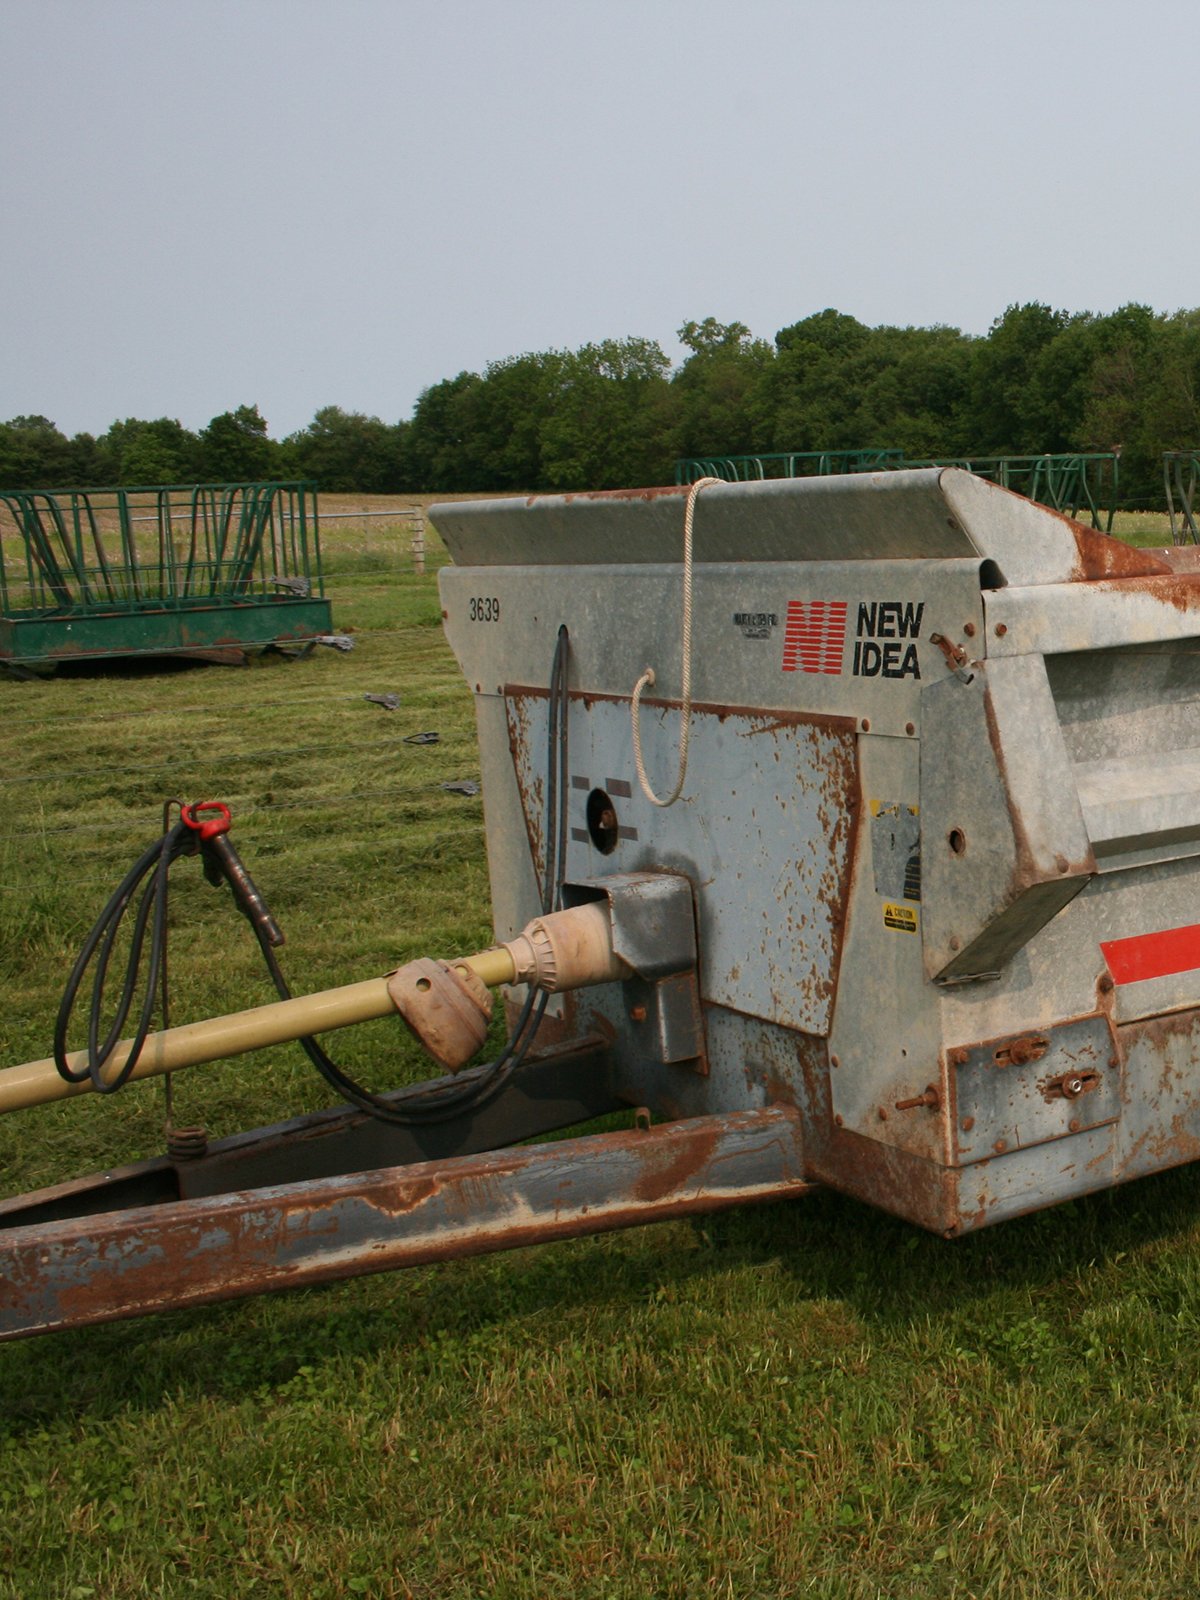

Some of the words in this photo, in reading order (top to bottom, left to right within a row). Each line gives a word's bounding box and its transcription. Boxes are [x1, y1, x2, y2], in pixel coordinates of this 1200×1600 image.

[469, 597, 500, 622] 3639
[857, 601, 925, 638] NEW
[852, 641, 922, 680] IDEA
